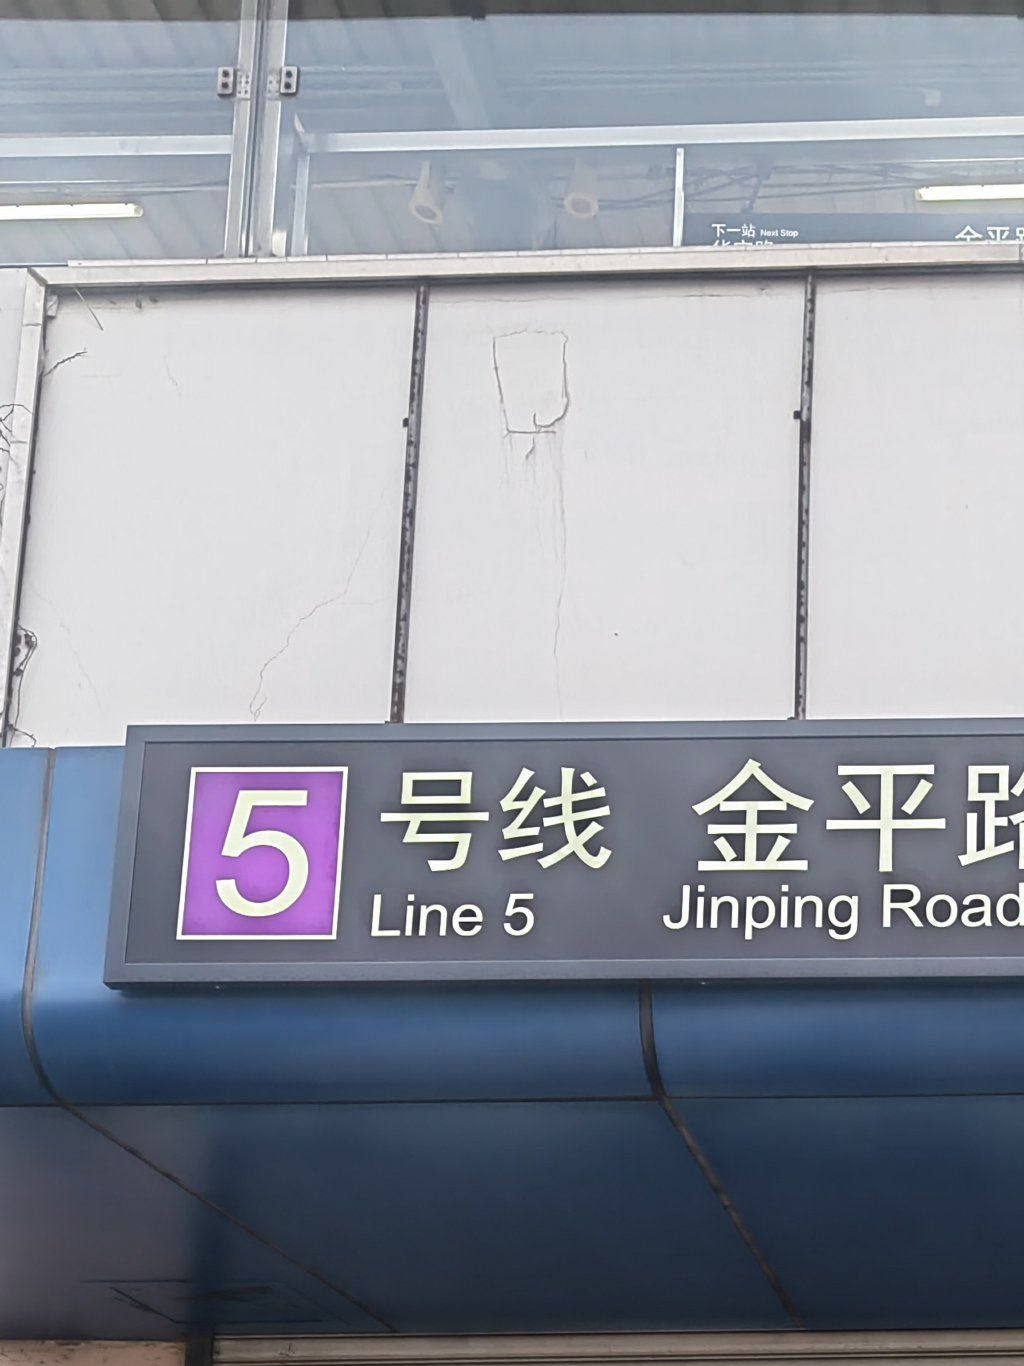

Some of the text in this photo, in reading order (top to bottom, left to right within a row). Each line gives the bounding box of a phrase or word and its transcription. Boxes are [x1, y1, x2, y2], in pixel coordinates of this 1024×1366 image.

[711, 223, 756, 238] 下一站
[760, 229, 799, 238] Next Stop
[215, 766, 612, 917] 5 号线
[370, 893, 535, 937] Line 5
[662, 884, 859, 940] Jinping
